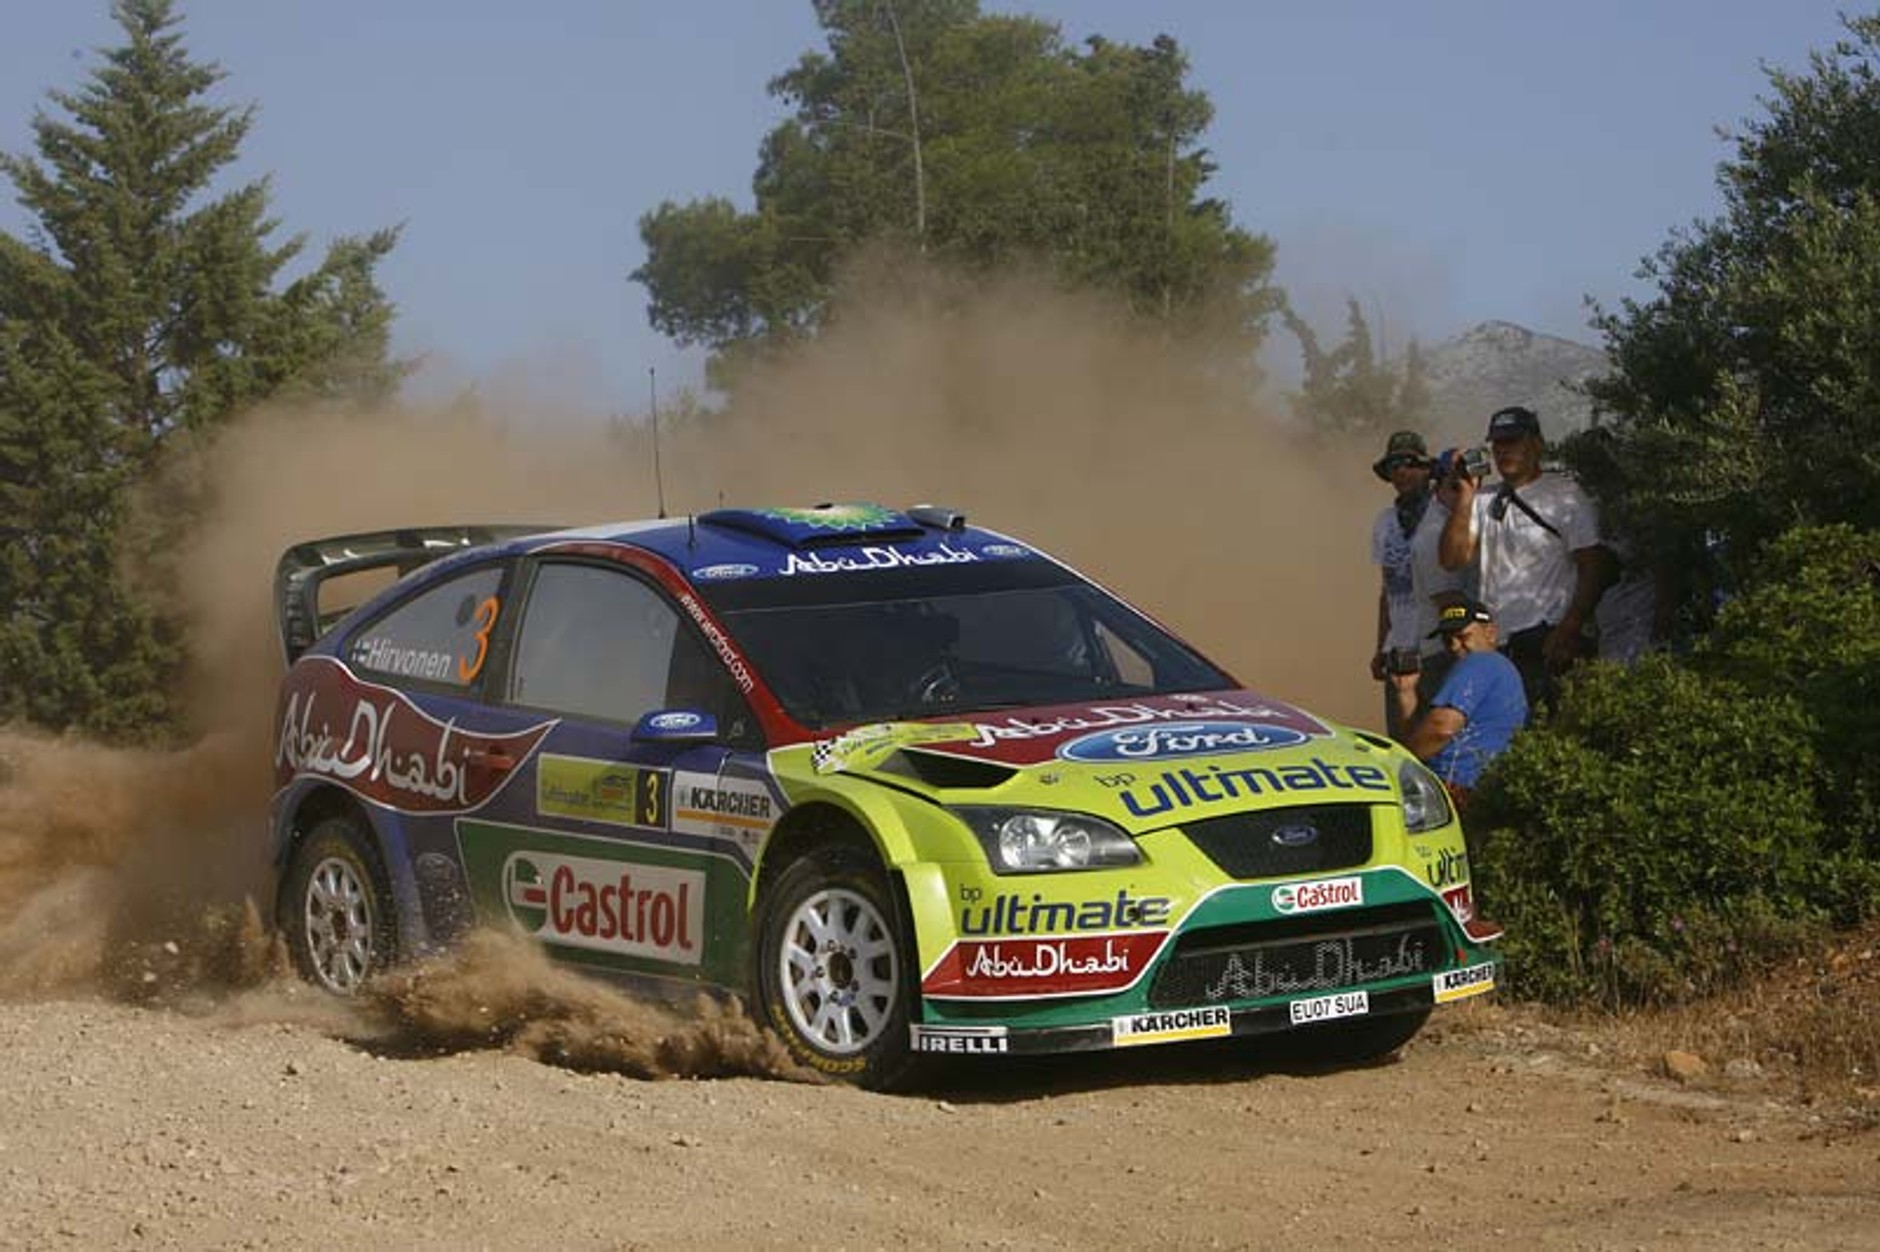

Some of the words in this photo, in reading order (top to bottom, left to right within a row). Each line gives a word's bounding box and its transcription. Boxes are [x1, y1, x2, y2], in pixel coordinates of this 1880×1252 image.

[459, 596, 501, 682] 3
[366, 640, 452, 678] Hirvonen
[1113, 725, 1271, 756] Ford
[1093, 772, 1136, 788] bp
[1119, 757, 1391, 817] ultimate
[645, 773, 659, 824] 3
[551, 865, 693, 950] Castrol
[960, 883, 982, 903] bp
[1297, 881, 1358, 908] Castrol
[961, 890, 1170, 934] ultimate
[1293, 1000, 1331, 1021] EU07
[1336, 995, 1368, 1014] SUA
[910, 1024, 1008, 1051] PIRELLI
